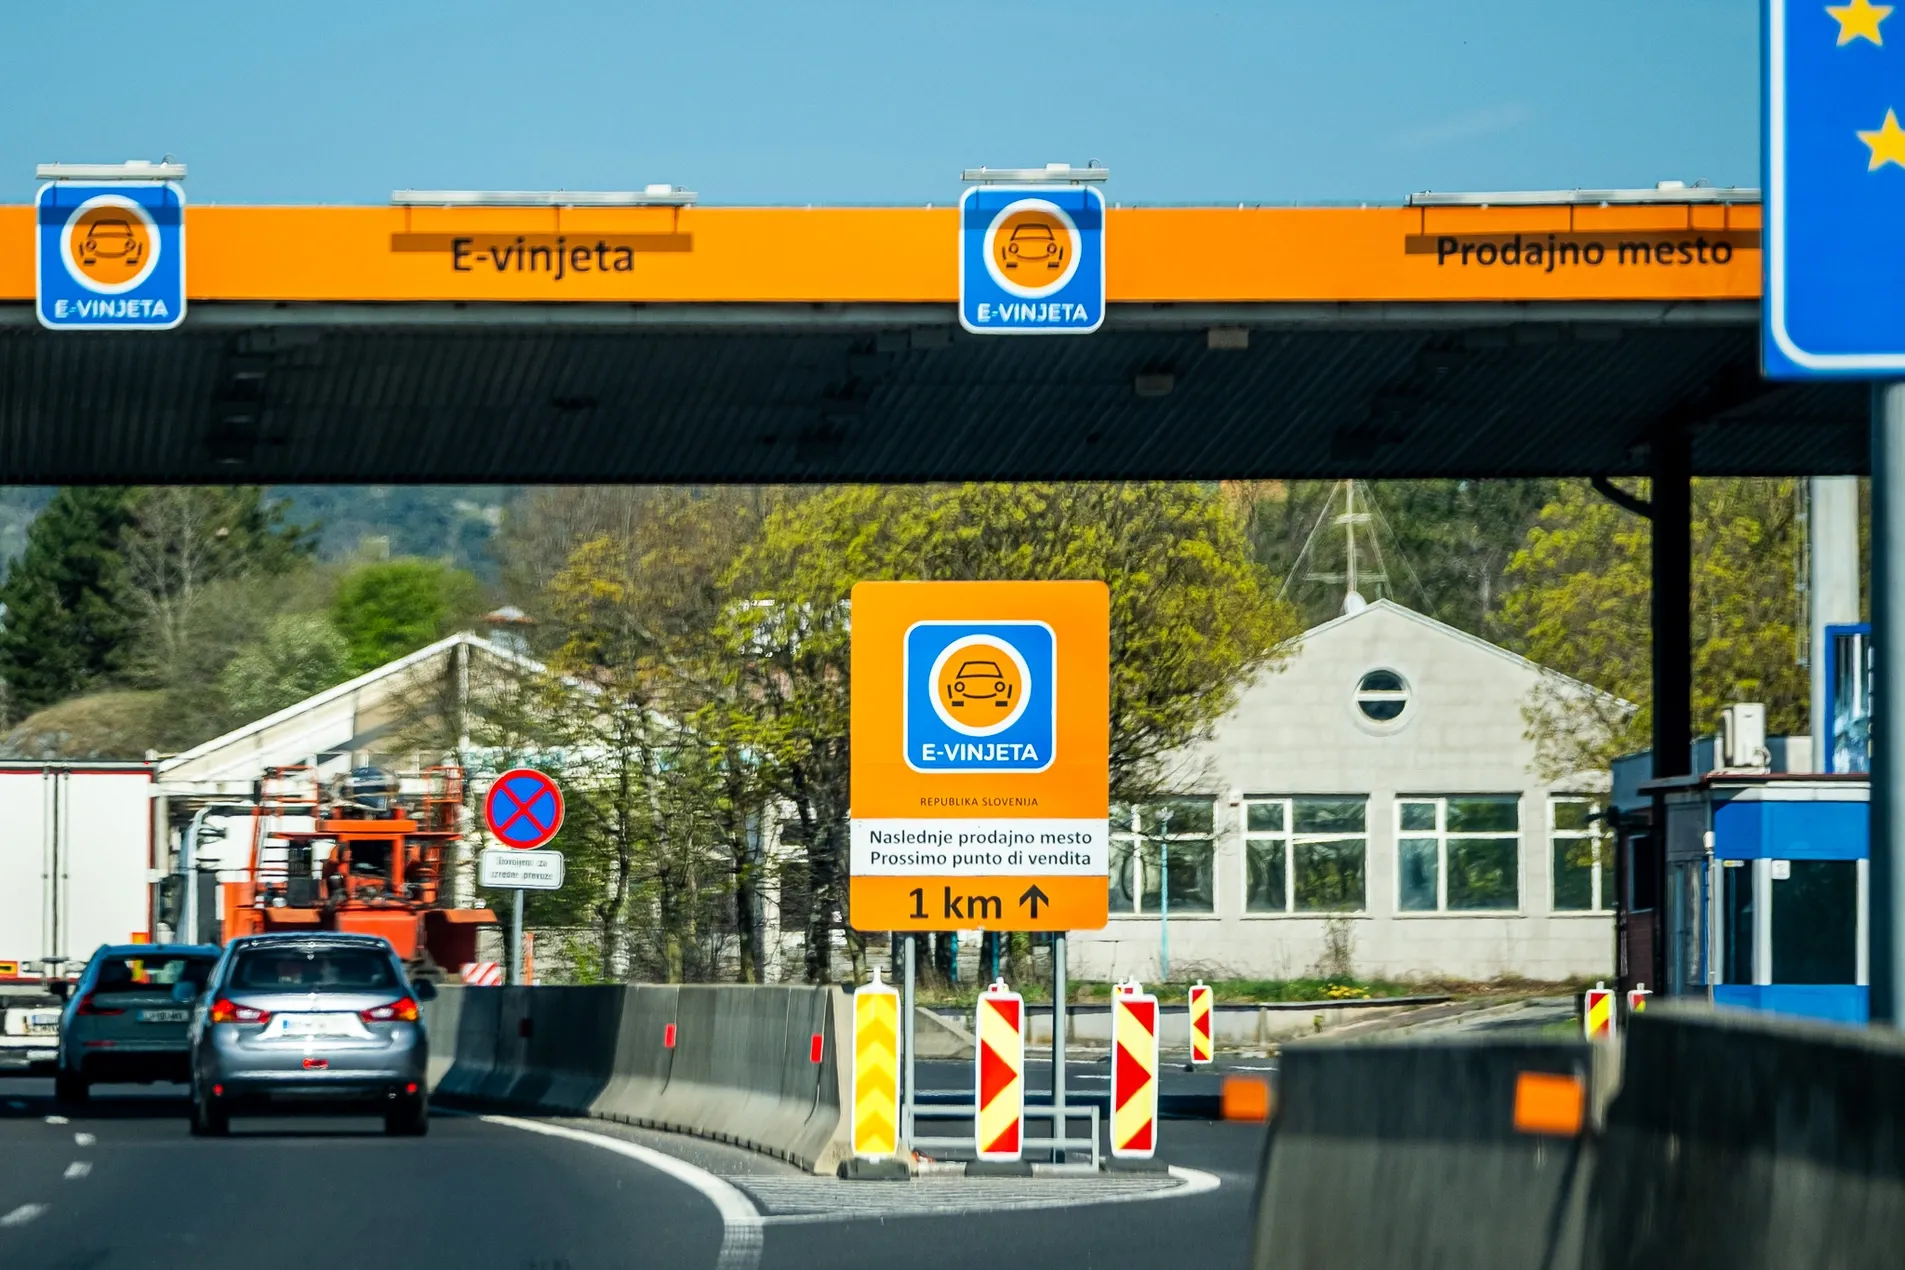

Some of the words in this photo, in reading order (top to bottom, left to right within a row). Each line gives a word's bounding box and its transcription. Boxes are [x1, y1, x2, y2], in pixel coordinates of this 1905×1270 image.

[452, 236, 635, 280] E-vinjeta
[1436, 233, 1605, 272] Prodajno
[1617, 236, 1733, 265] mesto
[55, 299, 168, 318] E-VINJETA
[977, 303, 1088, 322] E-VINJETA
[922, 743, 1039, 761] E-VINJETA
[920, 797, 979, 807] REPUBLIKA
[982, 797, 1039, 807] SLOVENIJA
[870, 829, 953, 847] Naslednje
[959, 829, 1035, 848] prodajno
[1041, 831, 1092, 845] mesto
[870, 850, 947, 865] Prossimo
[952, 852, 1002, 869] punto
[1007, 850, 1023, 865] di
[1028, 850, 1091, 866] vendita
[909, 888, 928, 919] 1
[944, 886, 1002, 919] km
